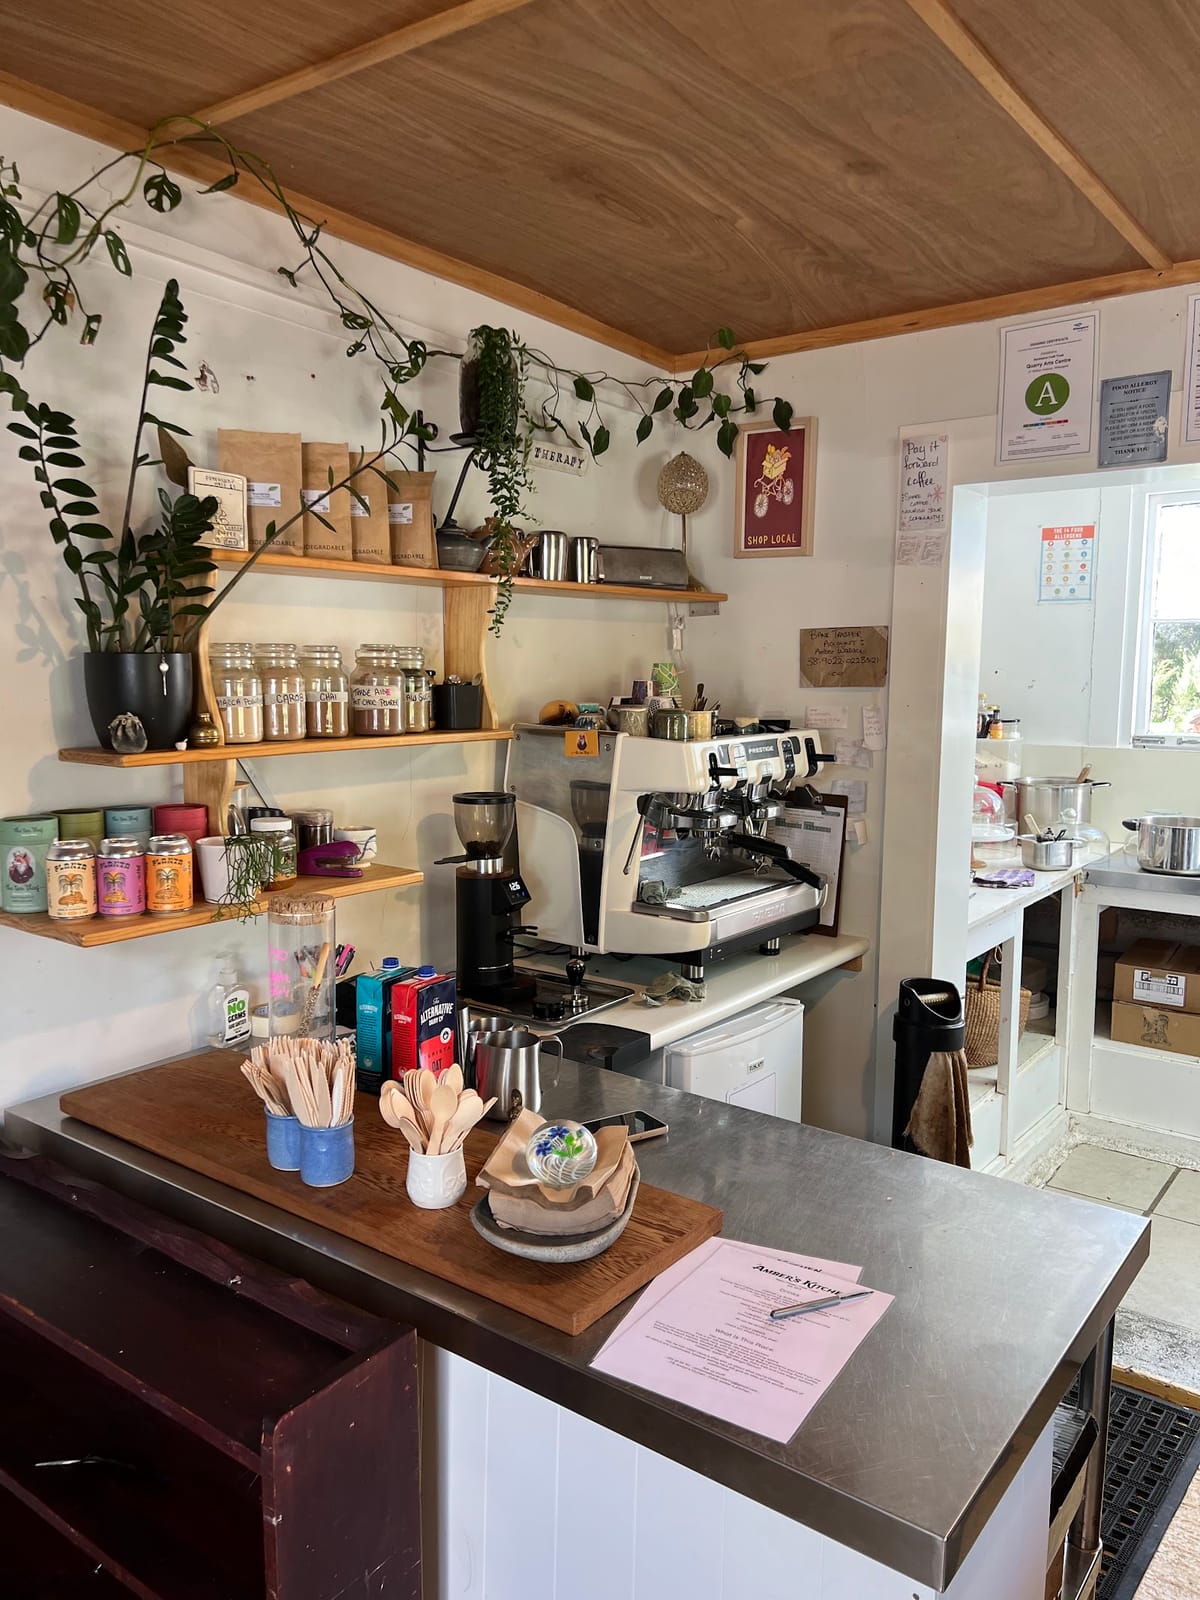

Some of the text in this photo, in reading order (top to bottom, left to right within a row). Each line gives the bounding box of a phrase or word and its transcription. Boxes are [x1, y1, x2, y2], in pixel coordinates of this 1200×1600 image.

[1112, 380, 1158, 392] FOOD ALLERGY
[1035, 381, 1058, 407] A
[534, 446, 584, 469] THERAPY
[907, 440, 940, 460] Pay it
[904, 455, 939, 471] forward
[907, 471, 935, 487] coffee
[747, 533, 797, 546] SHOP LOCAL
[320, 693, 337, 701] CHAI
[228, 1000, 246, 1015] NO
[420, 1002, 454, 1025] ALTERNATIVE
[228, 1010, 246, 1023] GERMS
[803, 1280, 840, 1295] KITCHE
